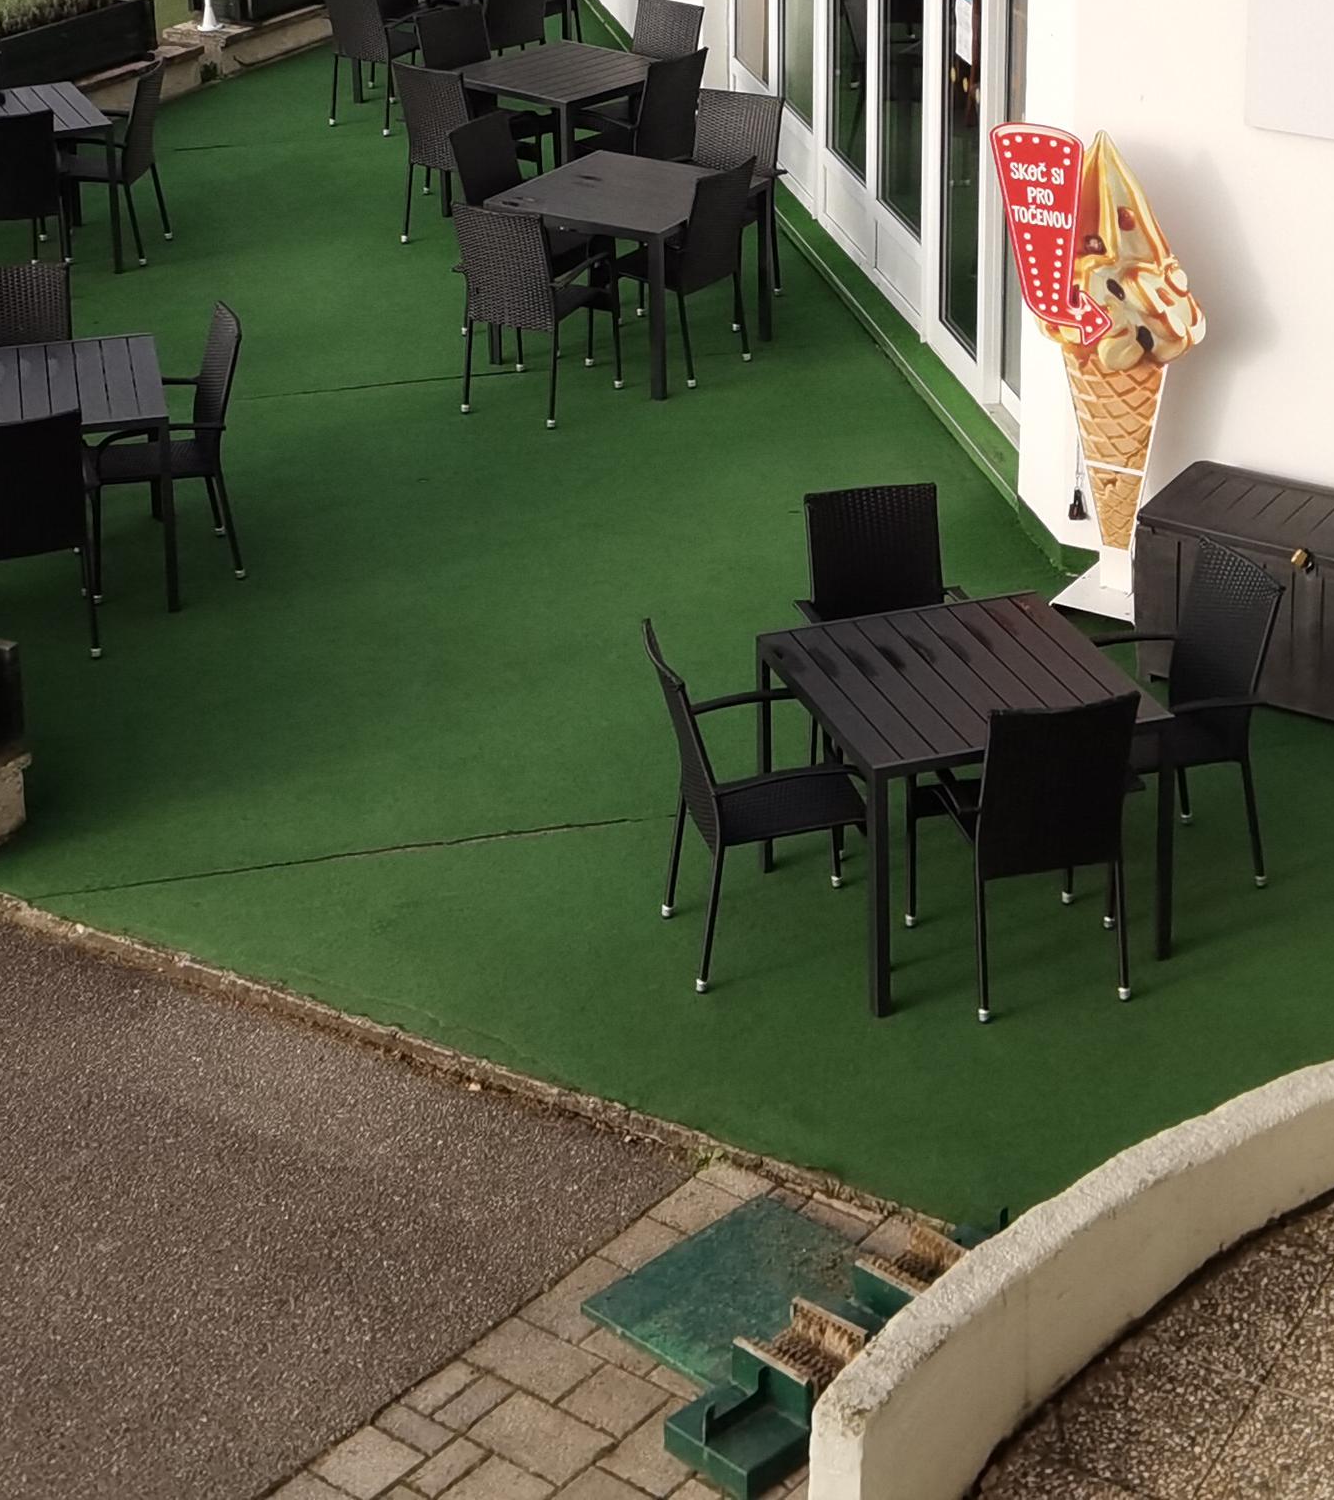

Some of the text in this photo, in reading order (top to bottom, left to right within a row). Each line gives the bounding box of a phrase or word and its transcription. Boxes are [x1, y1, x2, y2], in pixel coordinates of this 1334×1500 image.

[1010, 162, 1065, 186] SKOČ SI
[1026, 186, 1055, 206] PRO
[1011, 205, 1072, 230] TOČENOU
